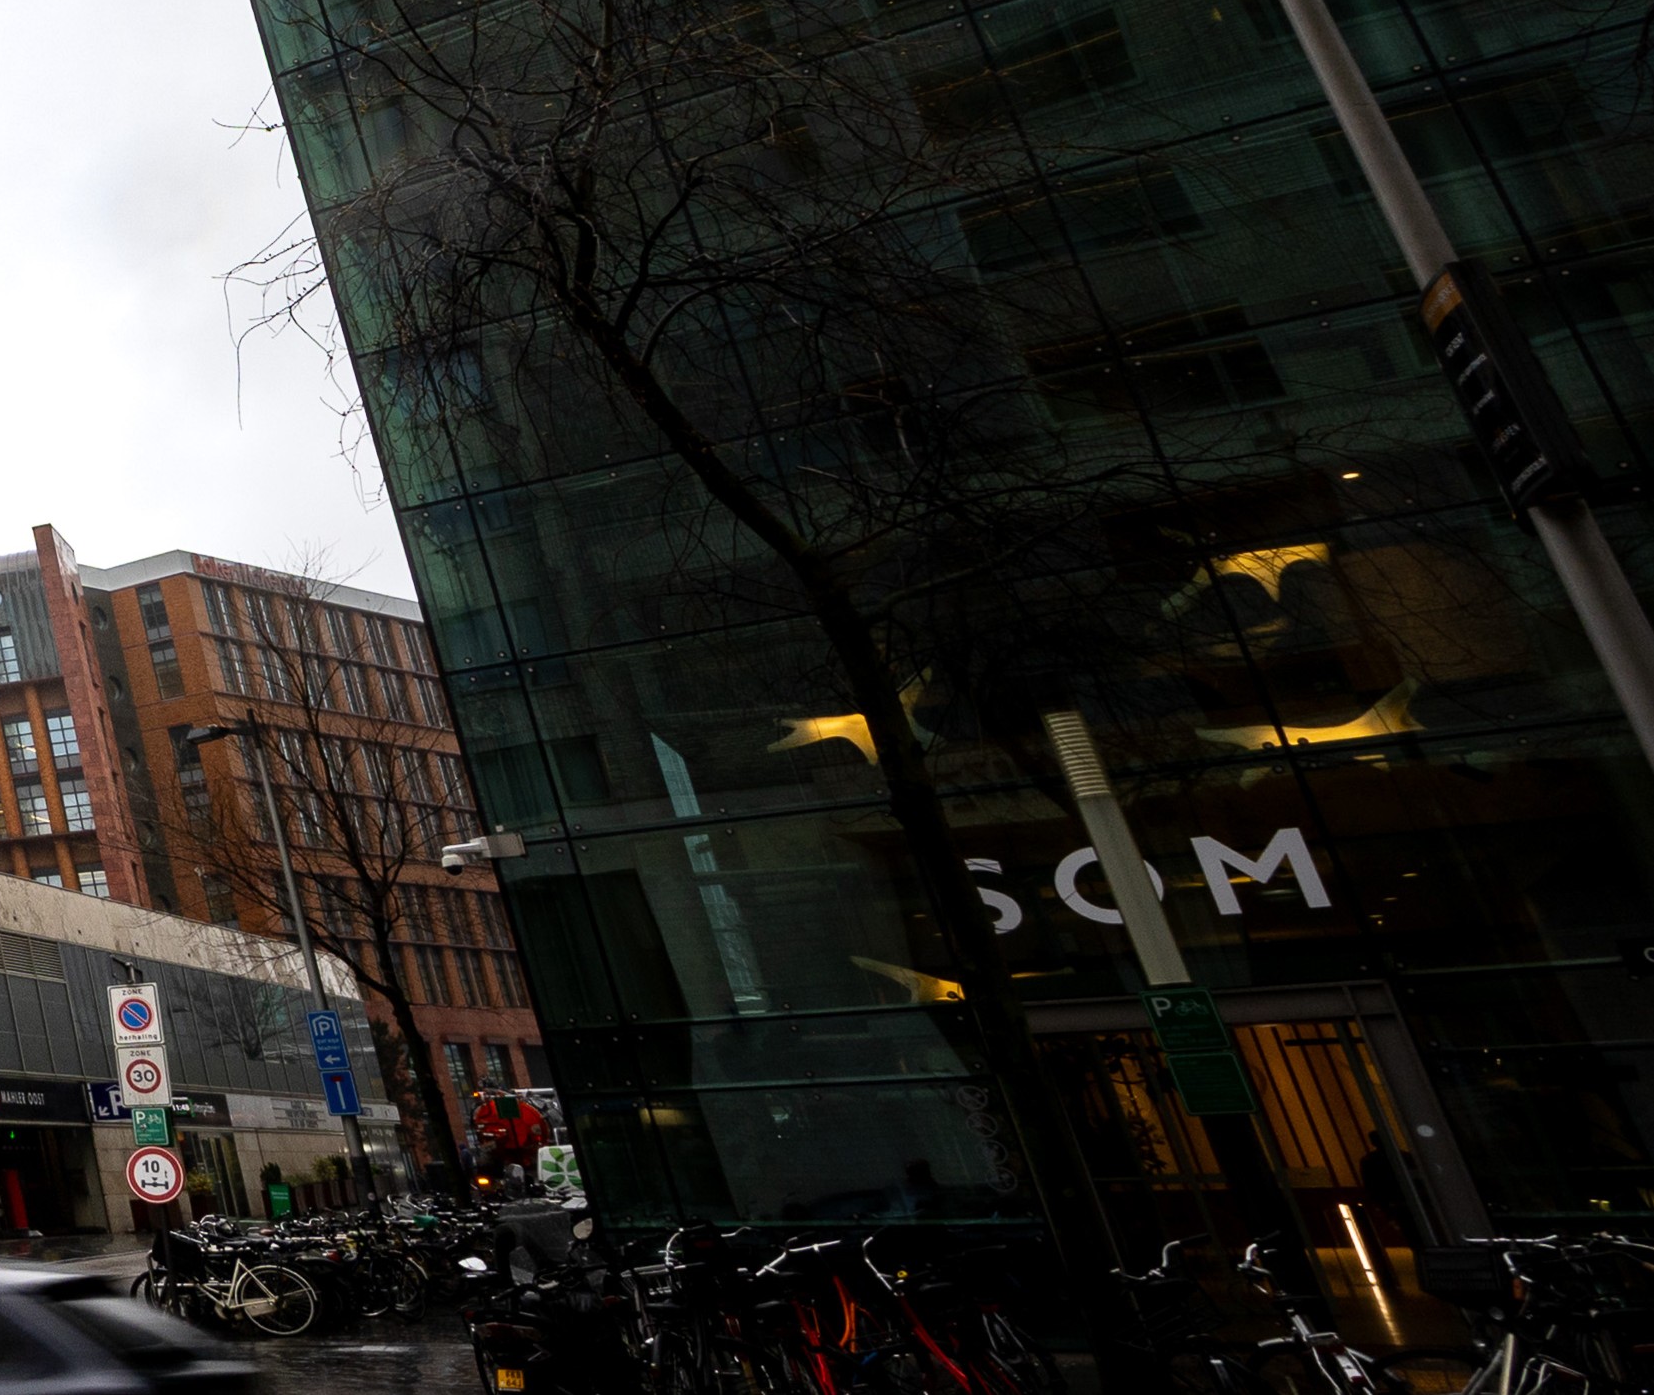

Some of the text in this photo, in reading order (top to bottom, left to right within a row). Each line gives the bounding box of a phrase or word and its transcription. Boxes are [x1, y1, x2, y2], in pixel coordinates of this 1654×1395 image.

[1150, 996, 1172, 1018] P
[318, 1021, 331, 1036] P
[132, 1069, 155, 1083] 30
[0, 1090, 26, 1104] MAHLER
[27, 1092, 45, 1106] OOST
[135, 1111, 146, 1124] P
[142, 1160, 160, 1173] 10
